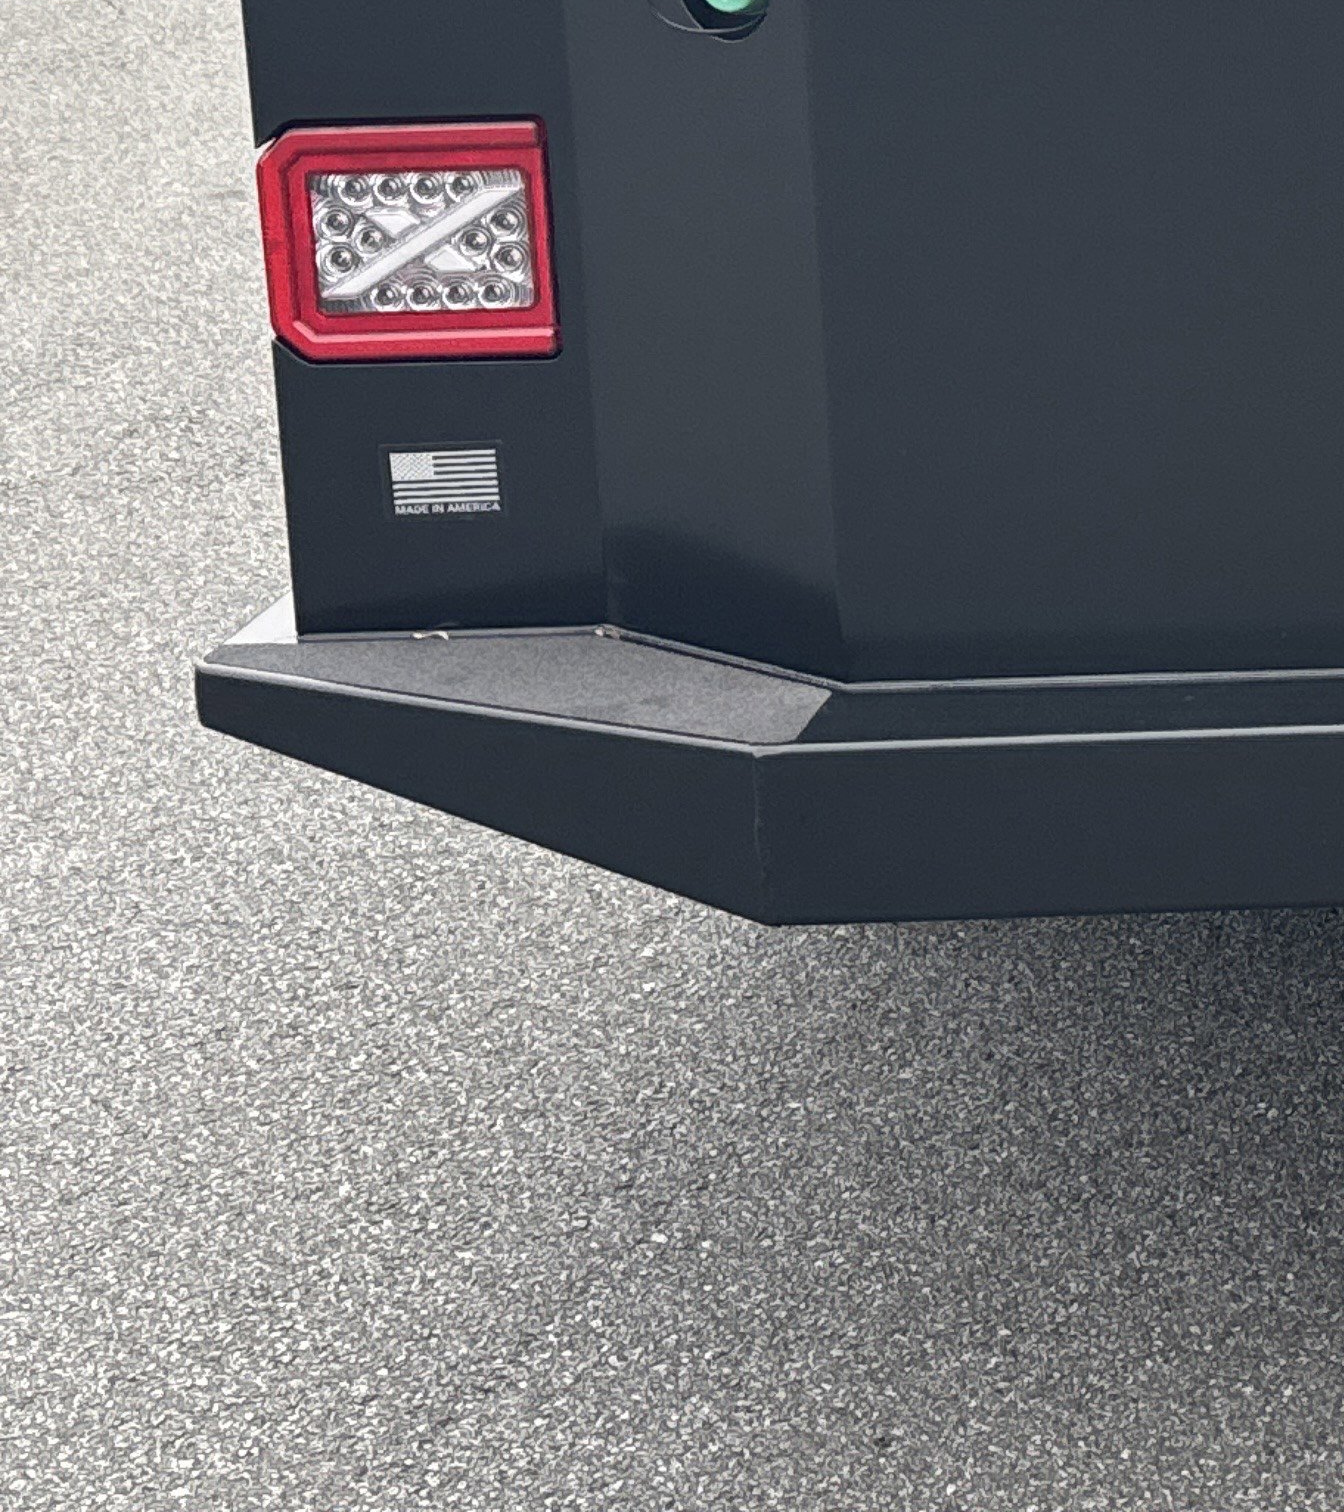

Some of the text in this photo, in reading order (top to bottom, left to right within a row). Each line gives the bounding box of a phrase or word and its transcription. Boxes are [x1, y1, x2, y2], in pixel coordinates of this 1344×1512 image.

[394, 501, 501, 515] MADE IN AMERICA
